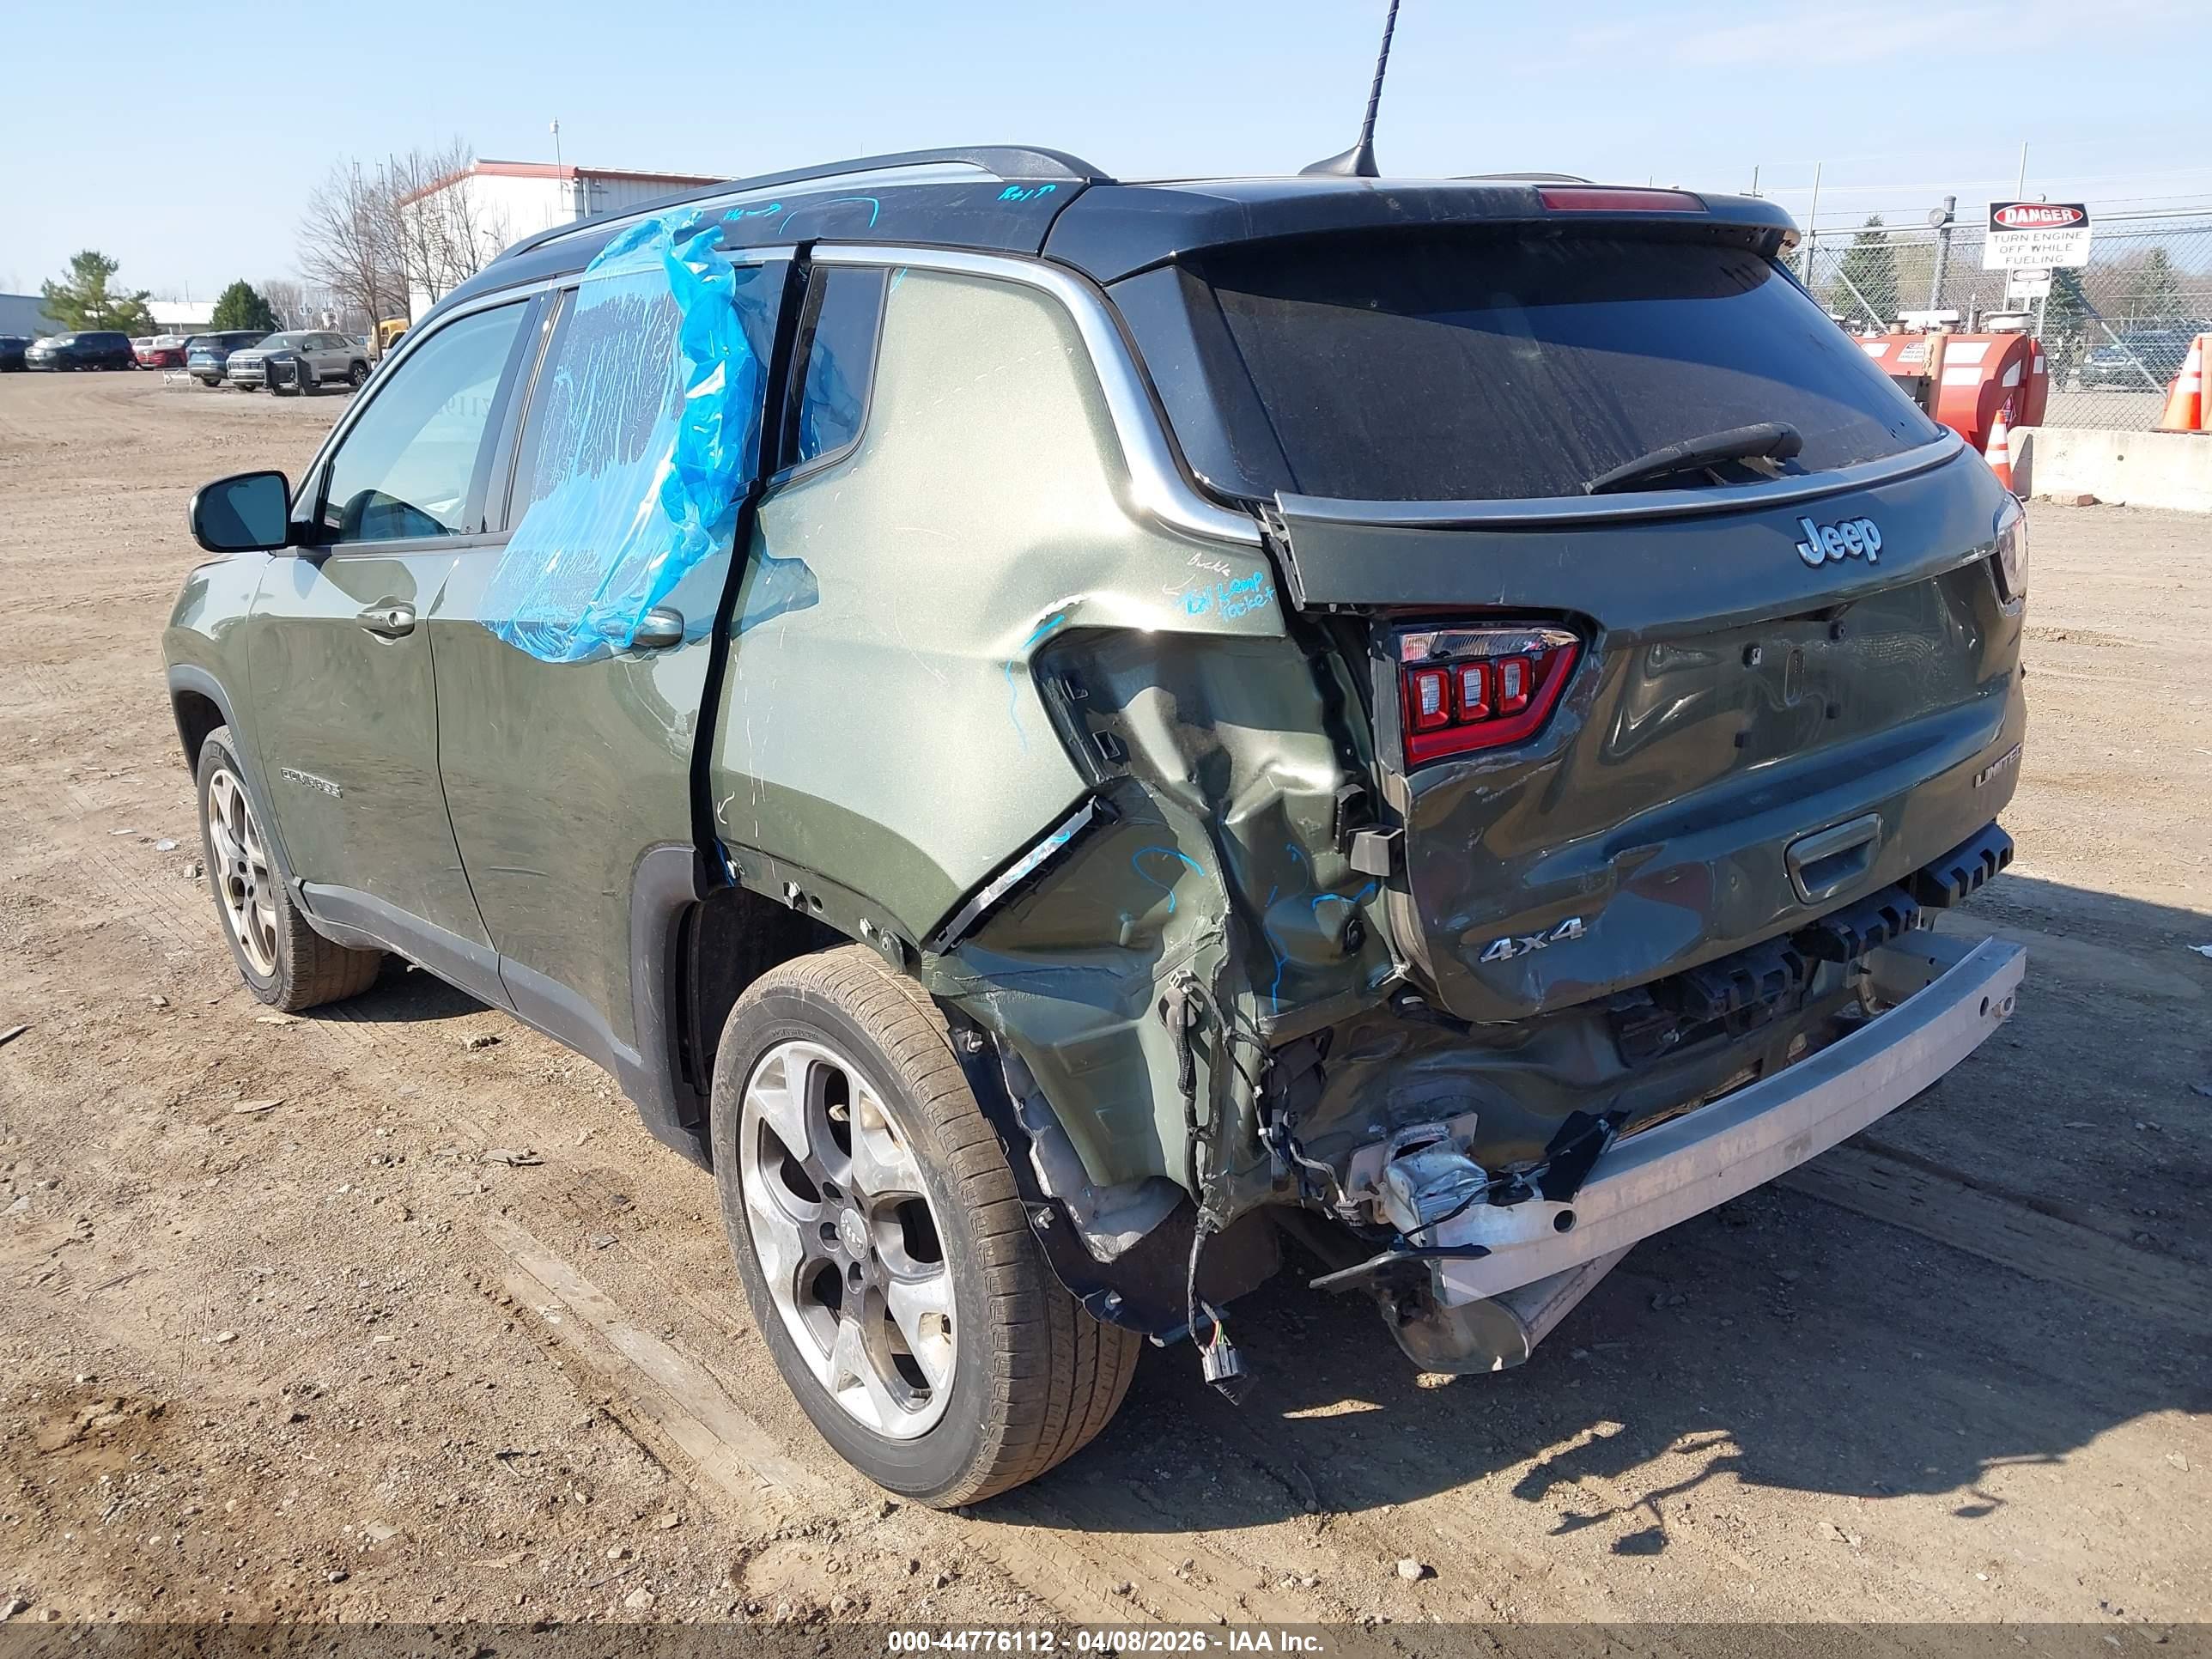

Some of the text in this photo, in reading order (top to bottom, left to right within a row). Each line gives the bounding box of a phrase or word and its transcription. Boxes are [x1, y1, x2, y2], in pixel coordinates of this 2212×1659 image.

[2004, 208, 2075, 224] DANGER
[1994, 231, 2084, 244] TURN ENGINE
[1999, 243, 2075, 254] OFF WHILE
[2005, 255, 2064, 264] FUELING
[1795, 516, 1882, 568] Jeep
[280, 767, 343, 799] COMPASS
[1479, 917, 1589, 963] 4x4
